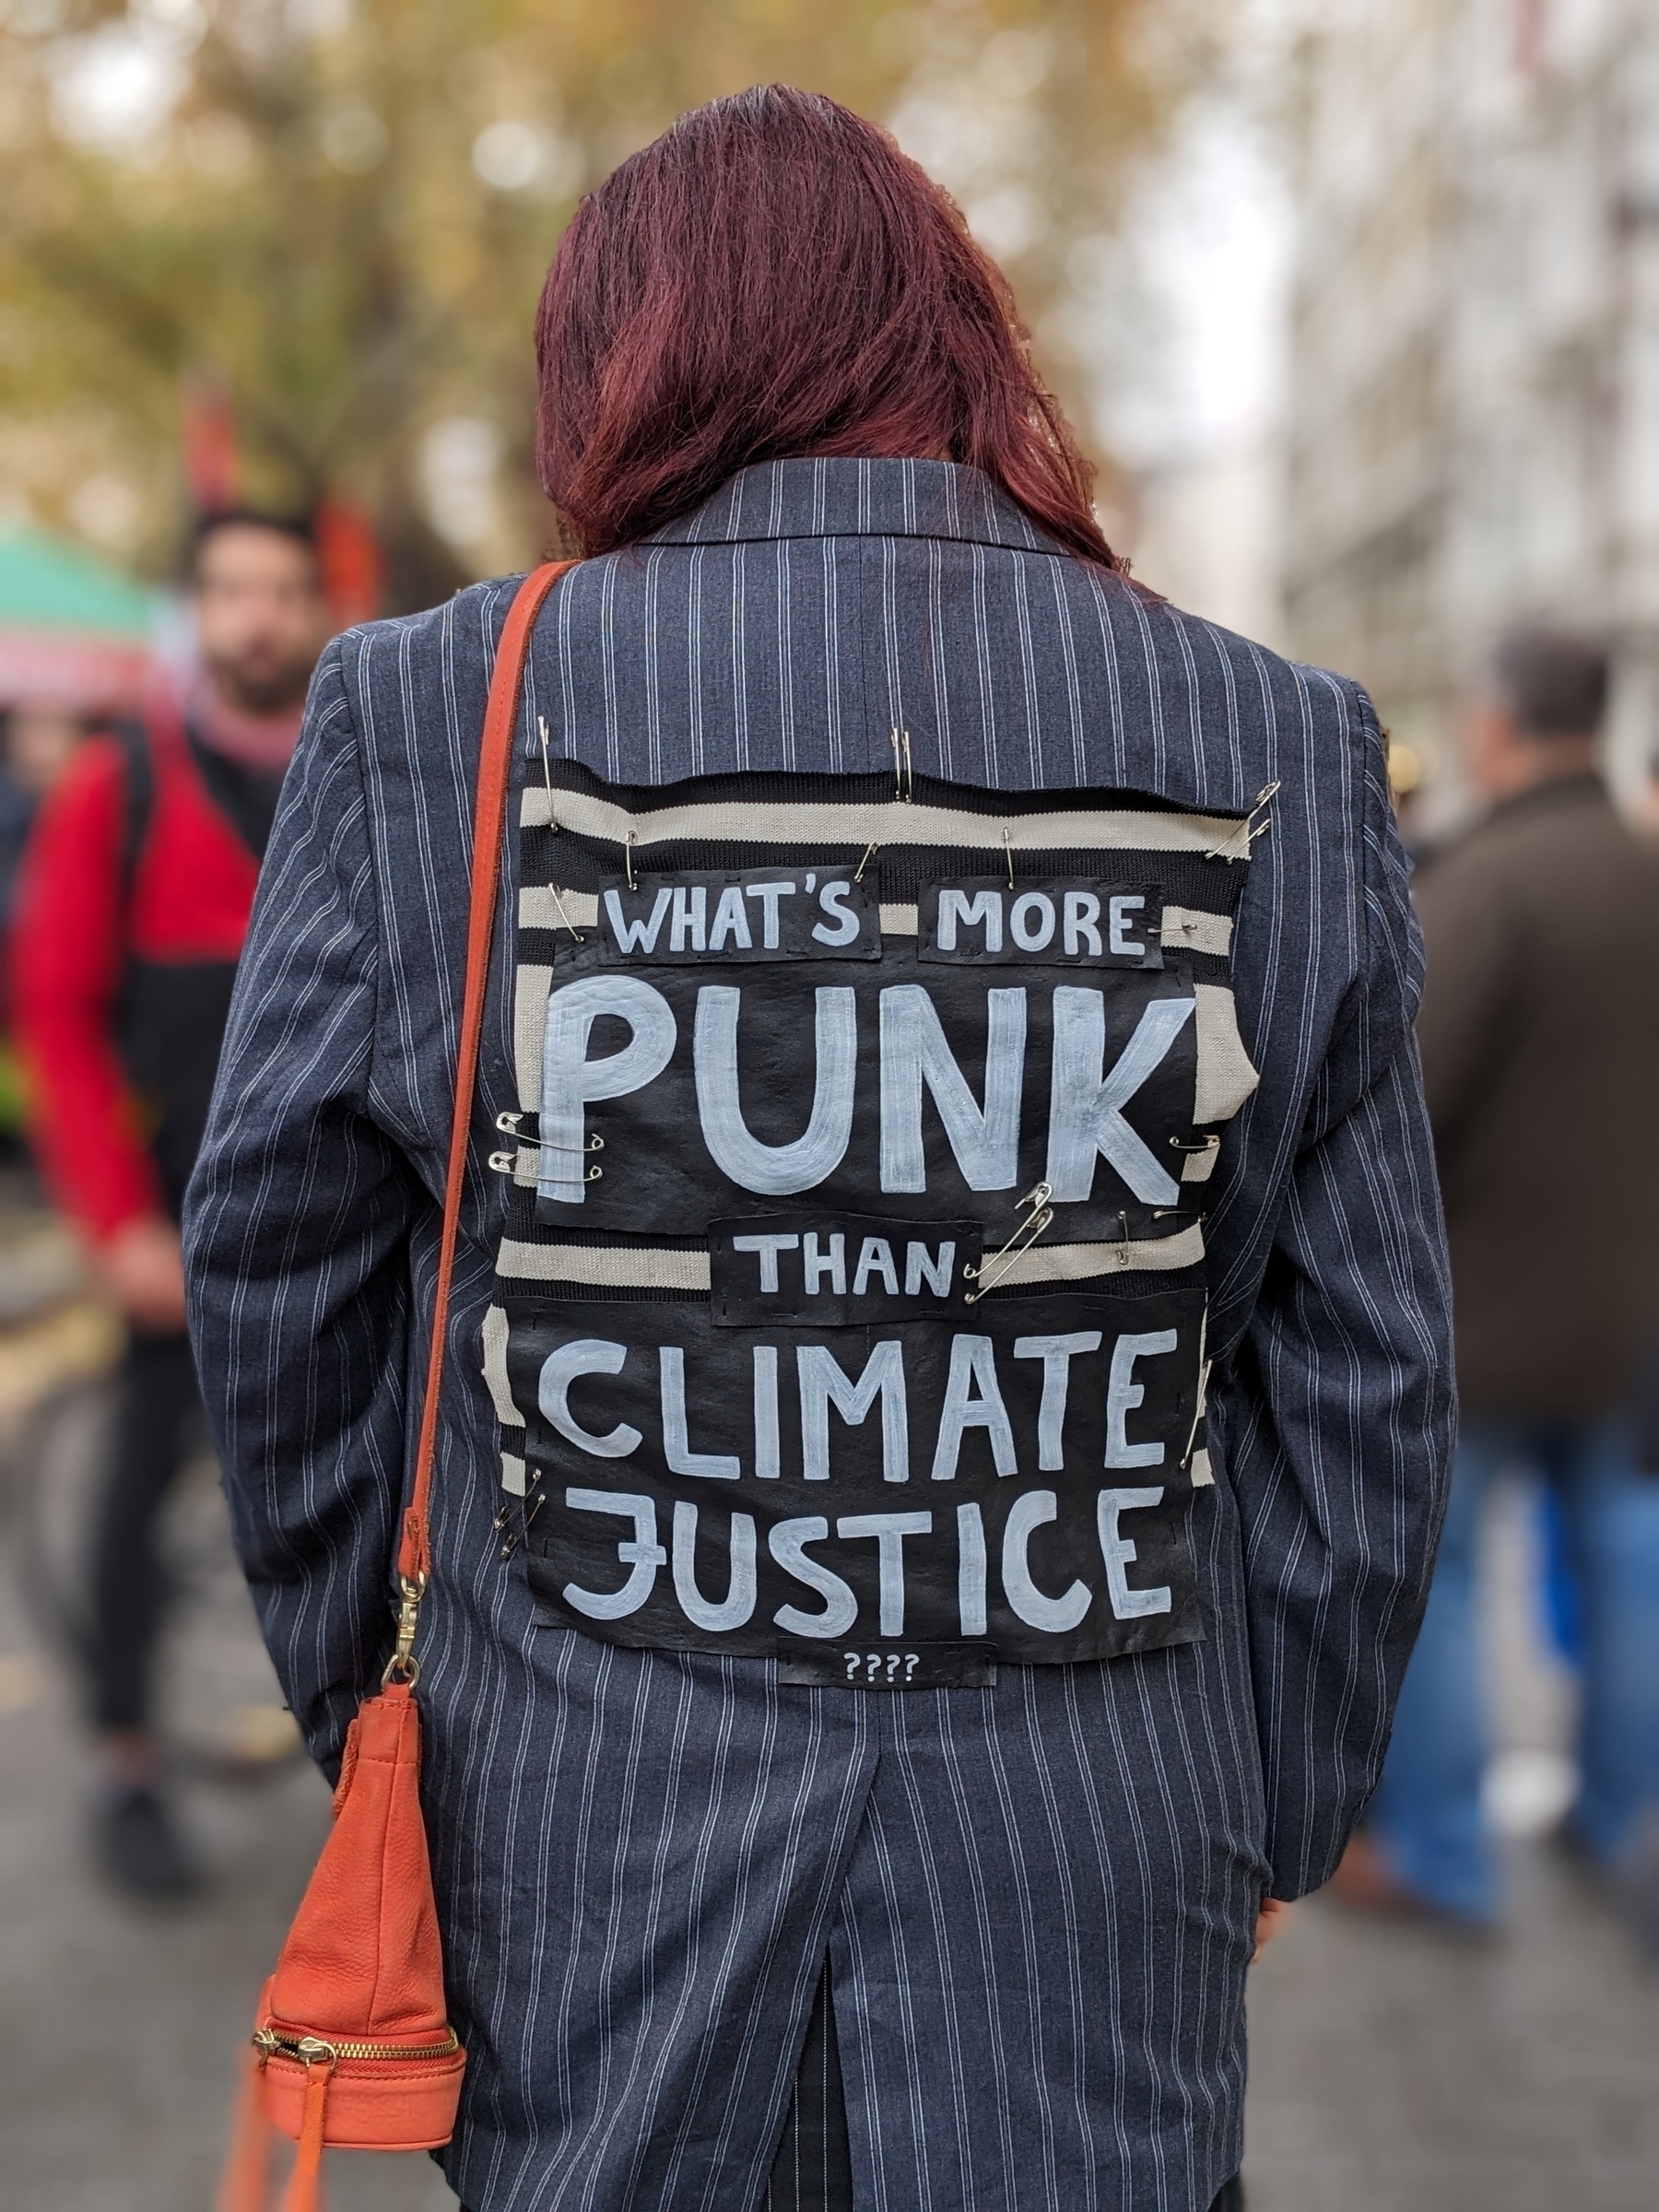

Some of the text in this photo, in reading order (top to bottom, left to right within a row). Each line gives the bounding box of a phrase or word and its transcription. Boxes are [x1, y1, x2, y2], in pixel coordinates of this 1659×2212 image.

[603, 874, 1146, 957] WHAT'S MORE
[537, 974, 1196, 1206] PUNK
[733, 1233, 956, 1297] THAN
[538, 1329, 1178, 1483] CLIMATE
[562, 1487, 1172, 1638] JUSTICE
[843, 1653, 920, 1682] ????
